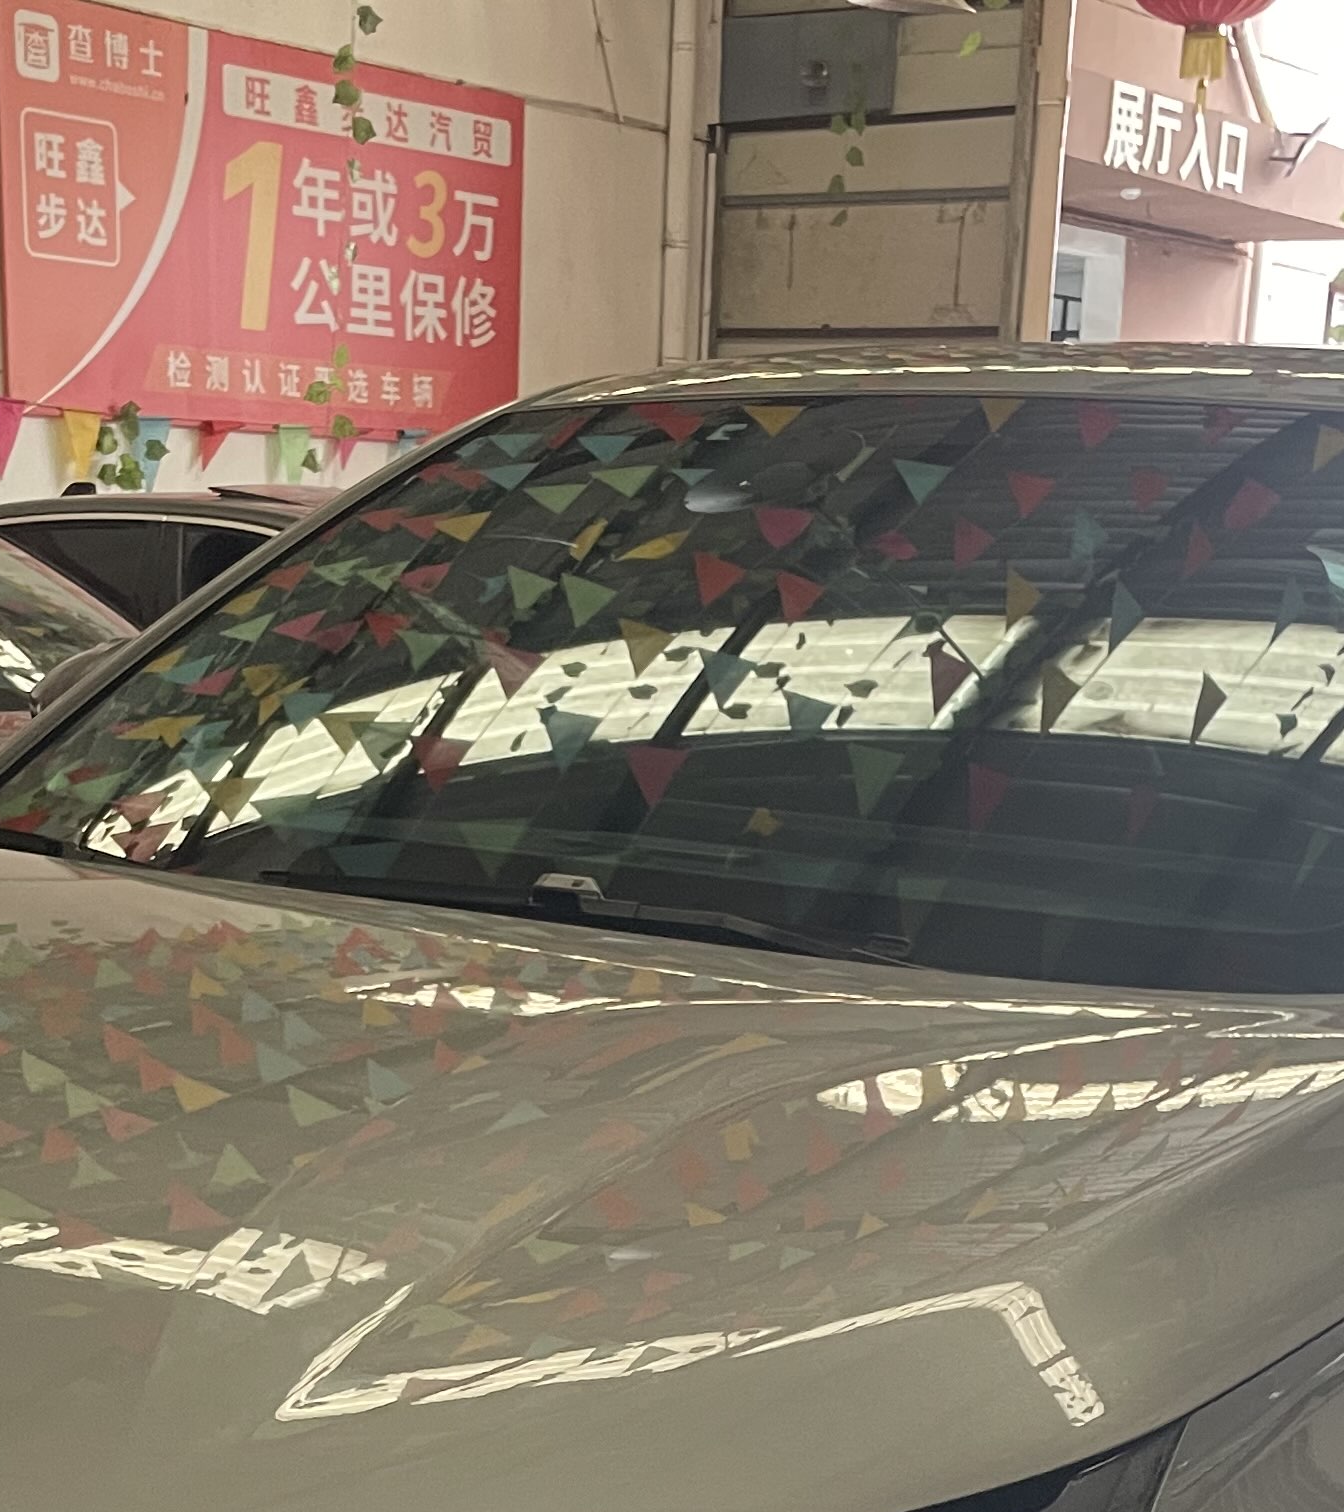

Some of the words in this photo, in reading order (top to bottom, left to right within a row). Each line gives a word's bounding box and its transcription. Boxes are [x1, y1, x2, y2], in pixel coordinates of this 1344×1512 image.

[66, 24, 164, 78] 查博士
[33, 132, 107, 186] 旺鑫
[1103, 79, 1249, 194] 展厅入口
[35, 192, 108, 247] 步达
[290, 256, 497, 348] 公里保修
